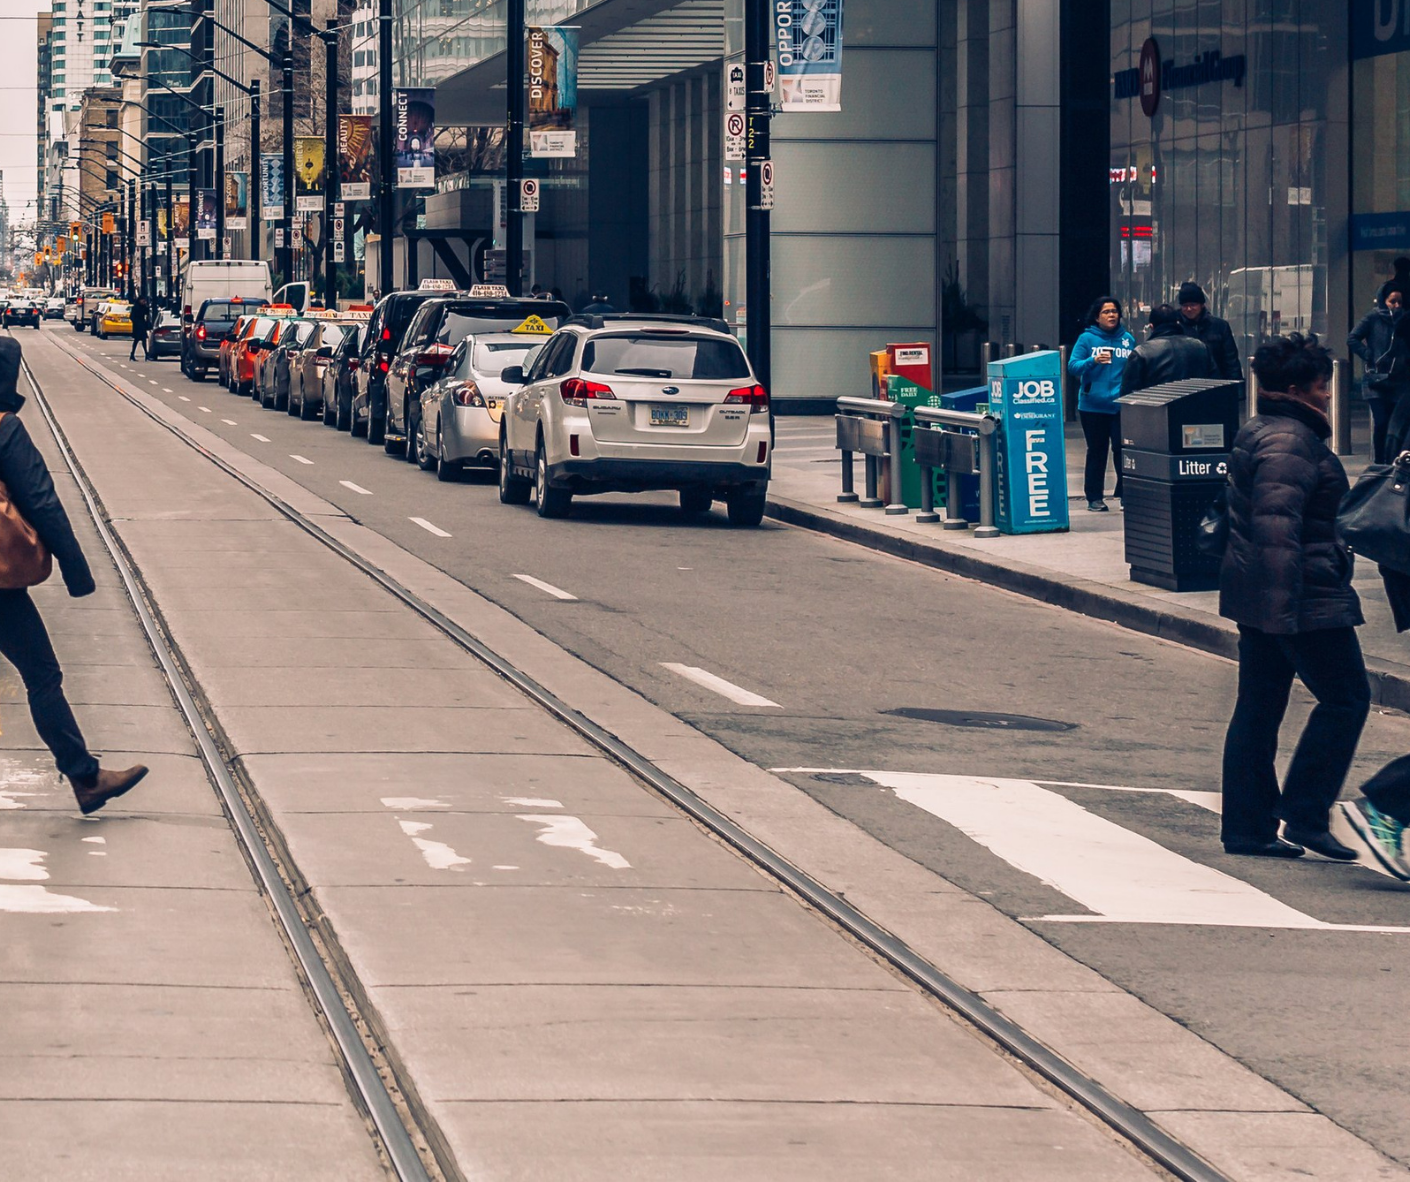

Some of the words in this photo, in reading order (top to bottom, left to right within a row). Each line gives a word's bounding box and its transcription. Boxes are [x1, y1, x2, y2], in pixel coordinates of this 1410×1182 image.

[531, 32, 543, 99] DISCOVER
[398, 92, 408, 141] CONNECT
[340, 118, 348, 154] BEAUTY
[296, 140, 304, 173] ACHIEVE
[991, 380, 1003, 398] JOB
[1012, 380, 1055, 398] JOB
[1012, 397, 1055, 405] Classified.ca
[1025, 429, 1050, 517] FREE
[1178, 460, 1212, 475] Litter
